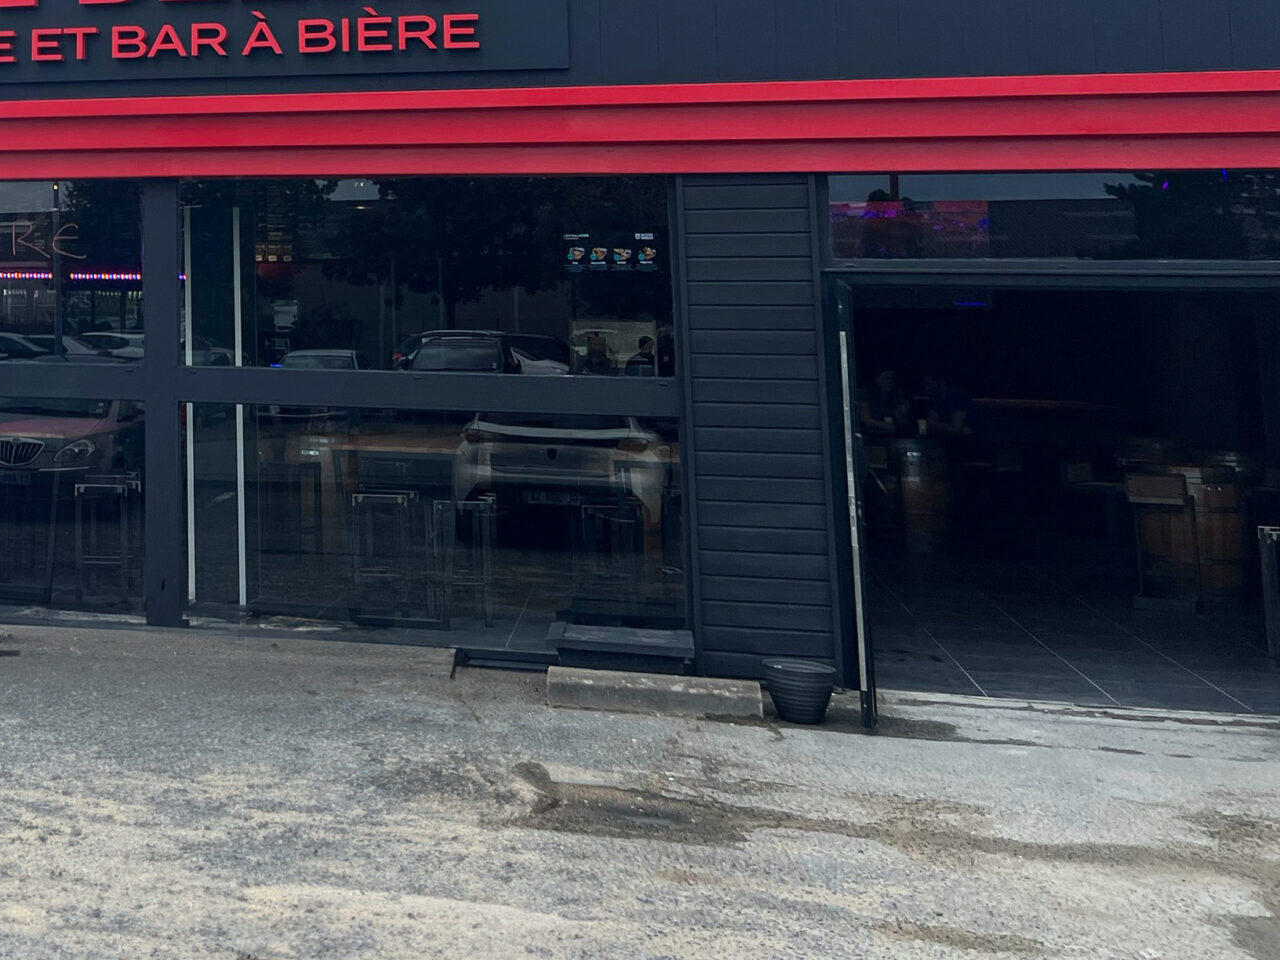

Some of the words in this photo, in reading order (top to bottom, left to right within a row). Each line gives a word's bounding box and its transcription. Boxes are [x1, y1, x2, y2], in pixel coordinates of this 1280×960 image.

[31, 26, 98, 61] ET
[111, 23, 228, 59] BAR
[241, 10, 282, 56] À
[297, 6, 481, 53] BIÈRE
